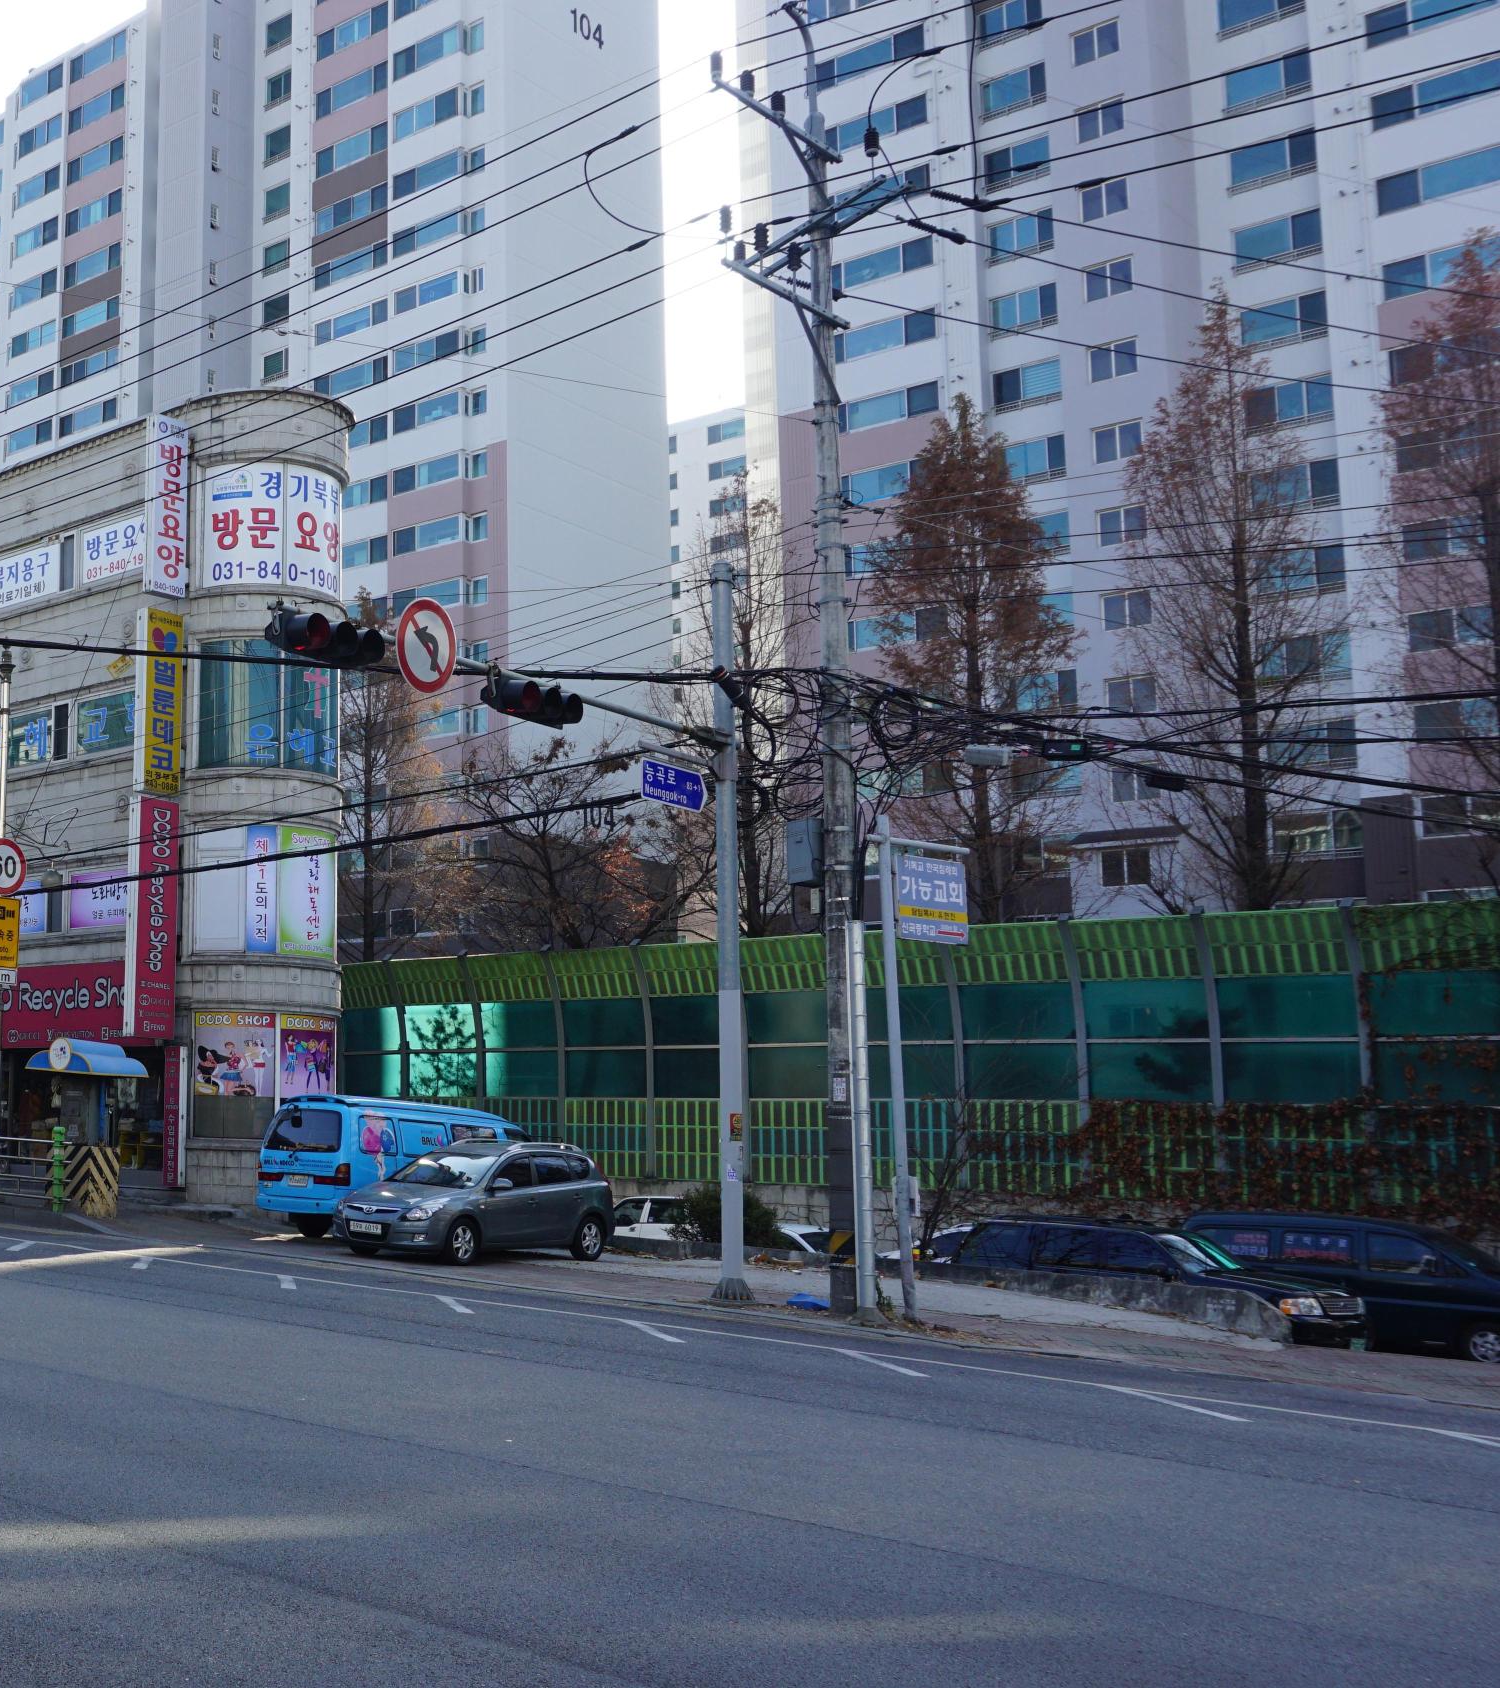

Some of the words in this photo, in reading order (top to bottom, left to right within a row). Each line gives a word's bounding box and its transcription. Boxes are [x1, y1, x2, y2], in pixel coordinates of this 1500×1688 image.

[570, 8, 604, 50] 104
[260, 472, 339, 514] 경기북부
[157, 443, 187, 580] 방문요양
[86, 523, 145, 561] 방문요
[212, 508, 279, 551] 방문
[294, 511, 339, 563] 요양
[86, 553, 143, 580] 031-840-19
[212, 560, 338, 594] 031-840-1900
[154, 582, 185, 596] 840-1900
[151, 659, 176, 771] 벌룬데코
[645, 763, 677, 786] 능곡로
[644, 783, 688, 804] Neunggok-ro
[901, 875, 964, 906] 가능교회
[144, 929, 168, 973] Shop
[17, 977, 90, 1017] Recycle
[94, 976, 126, 1009] Sho
[198, 1014, 232, 1025] DODO
[237, 1014, 271, 1026] SHOP
[286, 1017, 316, 1029] DODO
